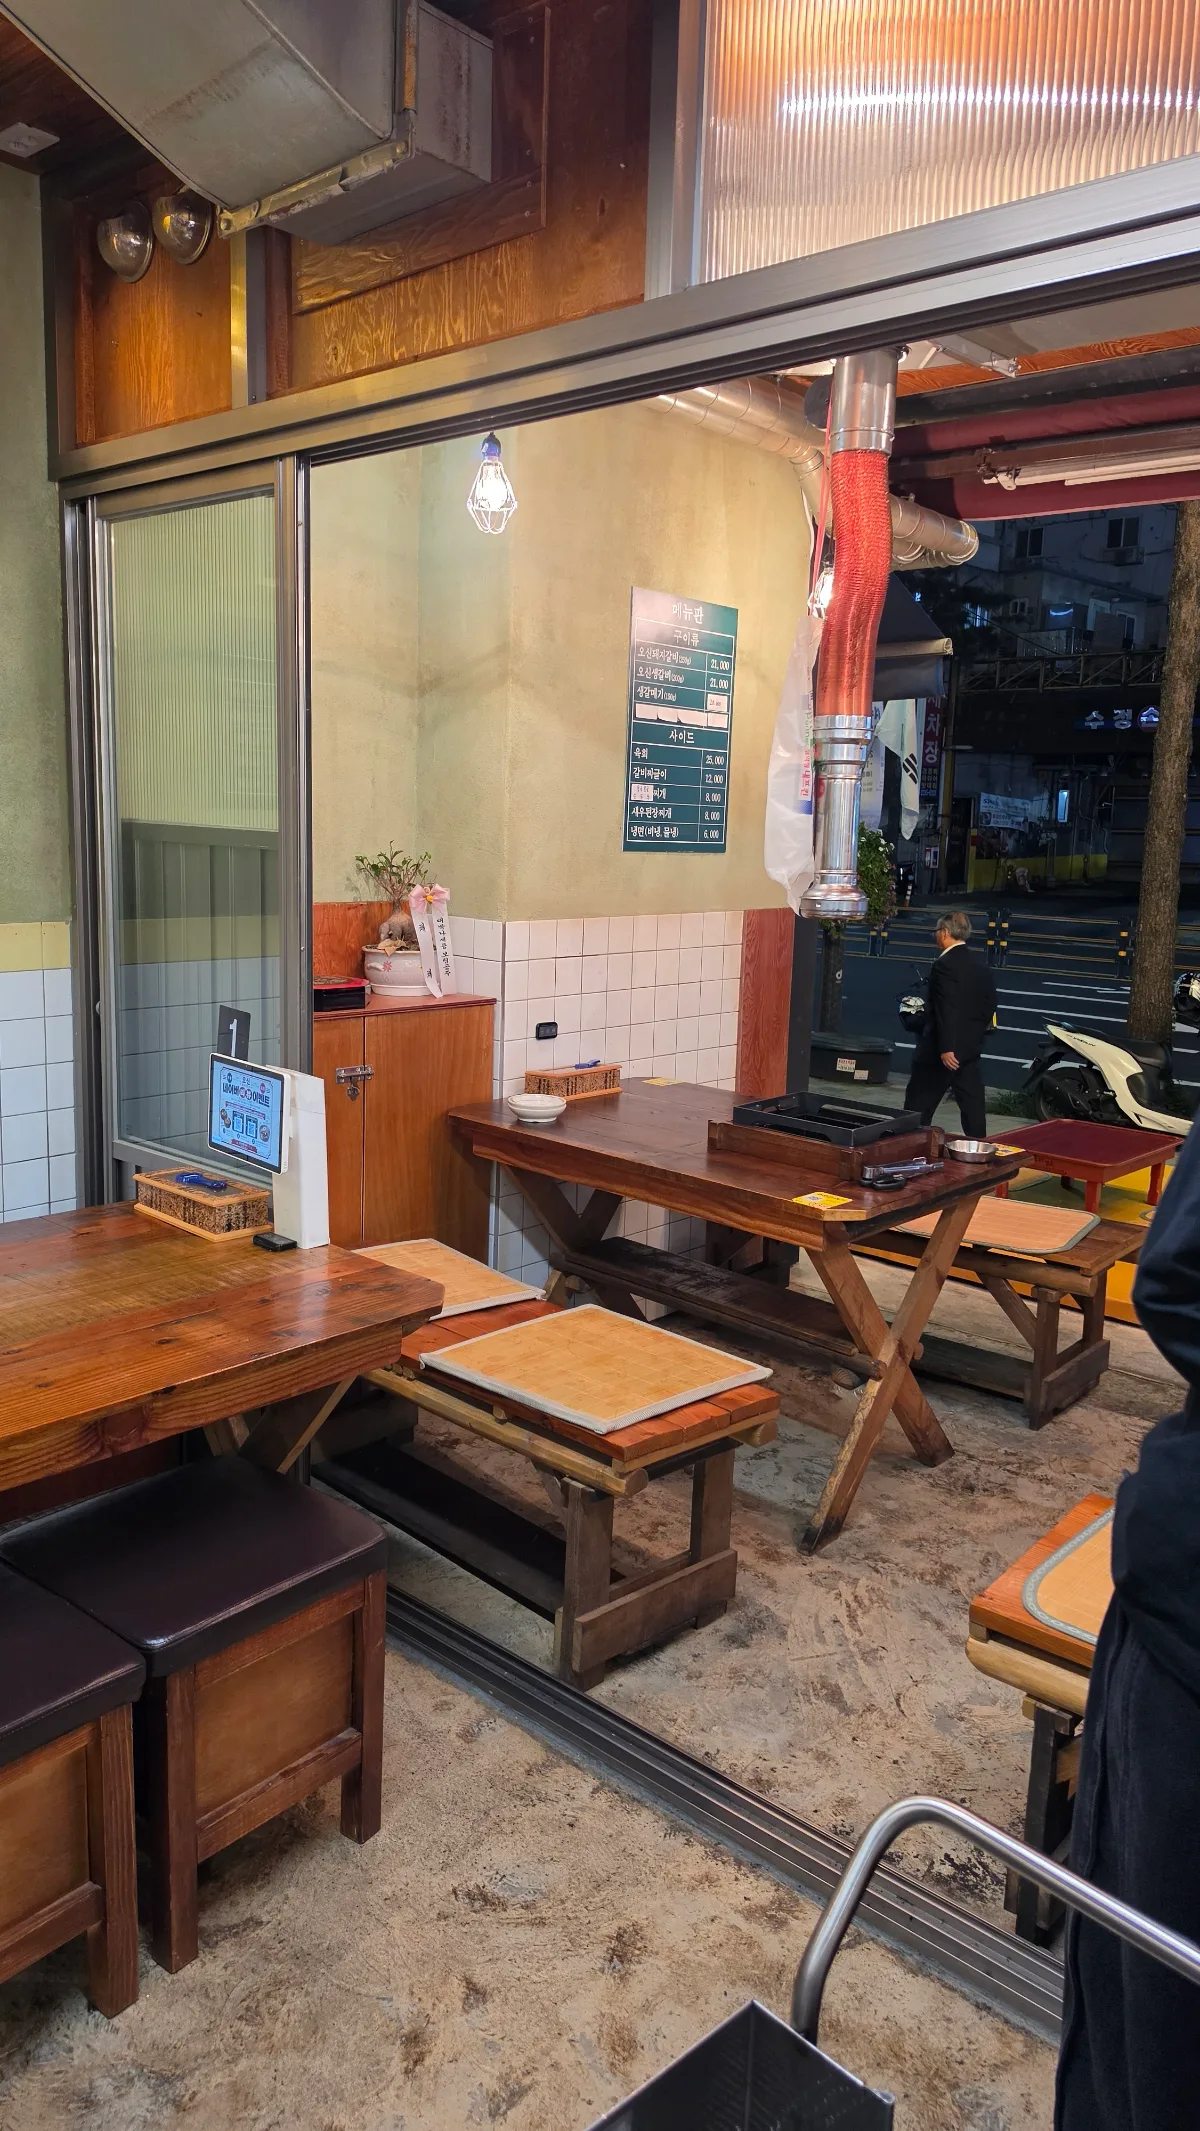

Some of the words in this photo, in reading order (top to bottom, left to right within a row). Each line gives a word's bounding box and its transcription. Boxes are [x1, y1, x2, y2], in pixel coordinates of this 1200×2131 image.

[672, 602, 704, 624] 메뉴판
[673, 629, 700, 647] 구이류
[668, 729, 695, 744] 사이드
[633, 747, 648, 759] 육회
[631, 806, 672, 819] 새우된장찌개
[229, 1018, 237, 1058] 1
